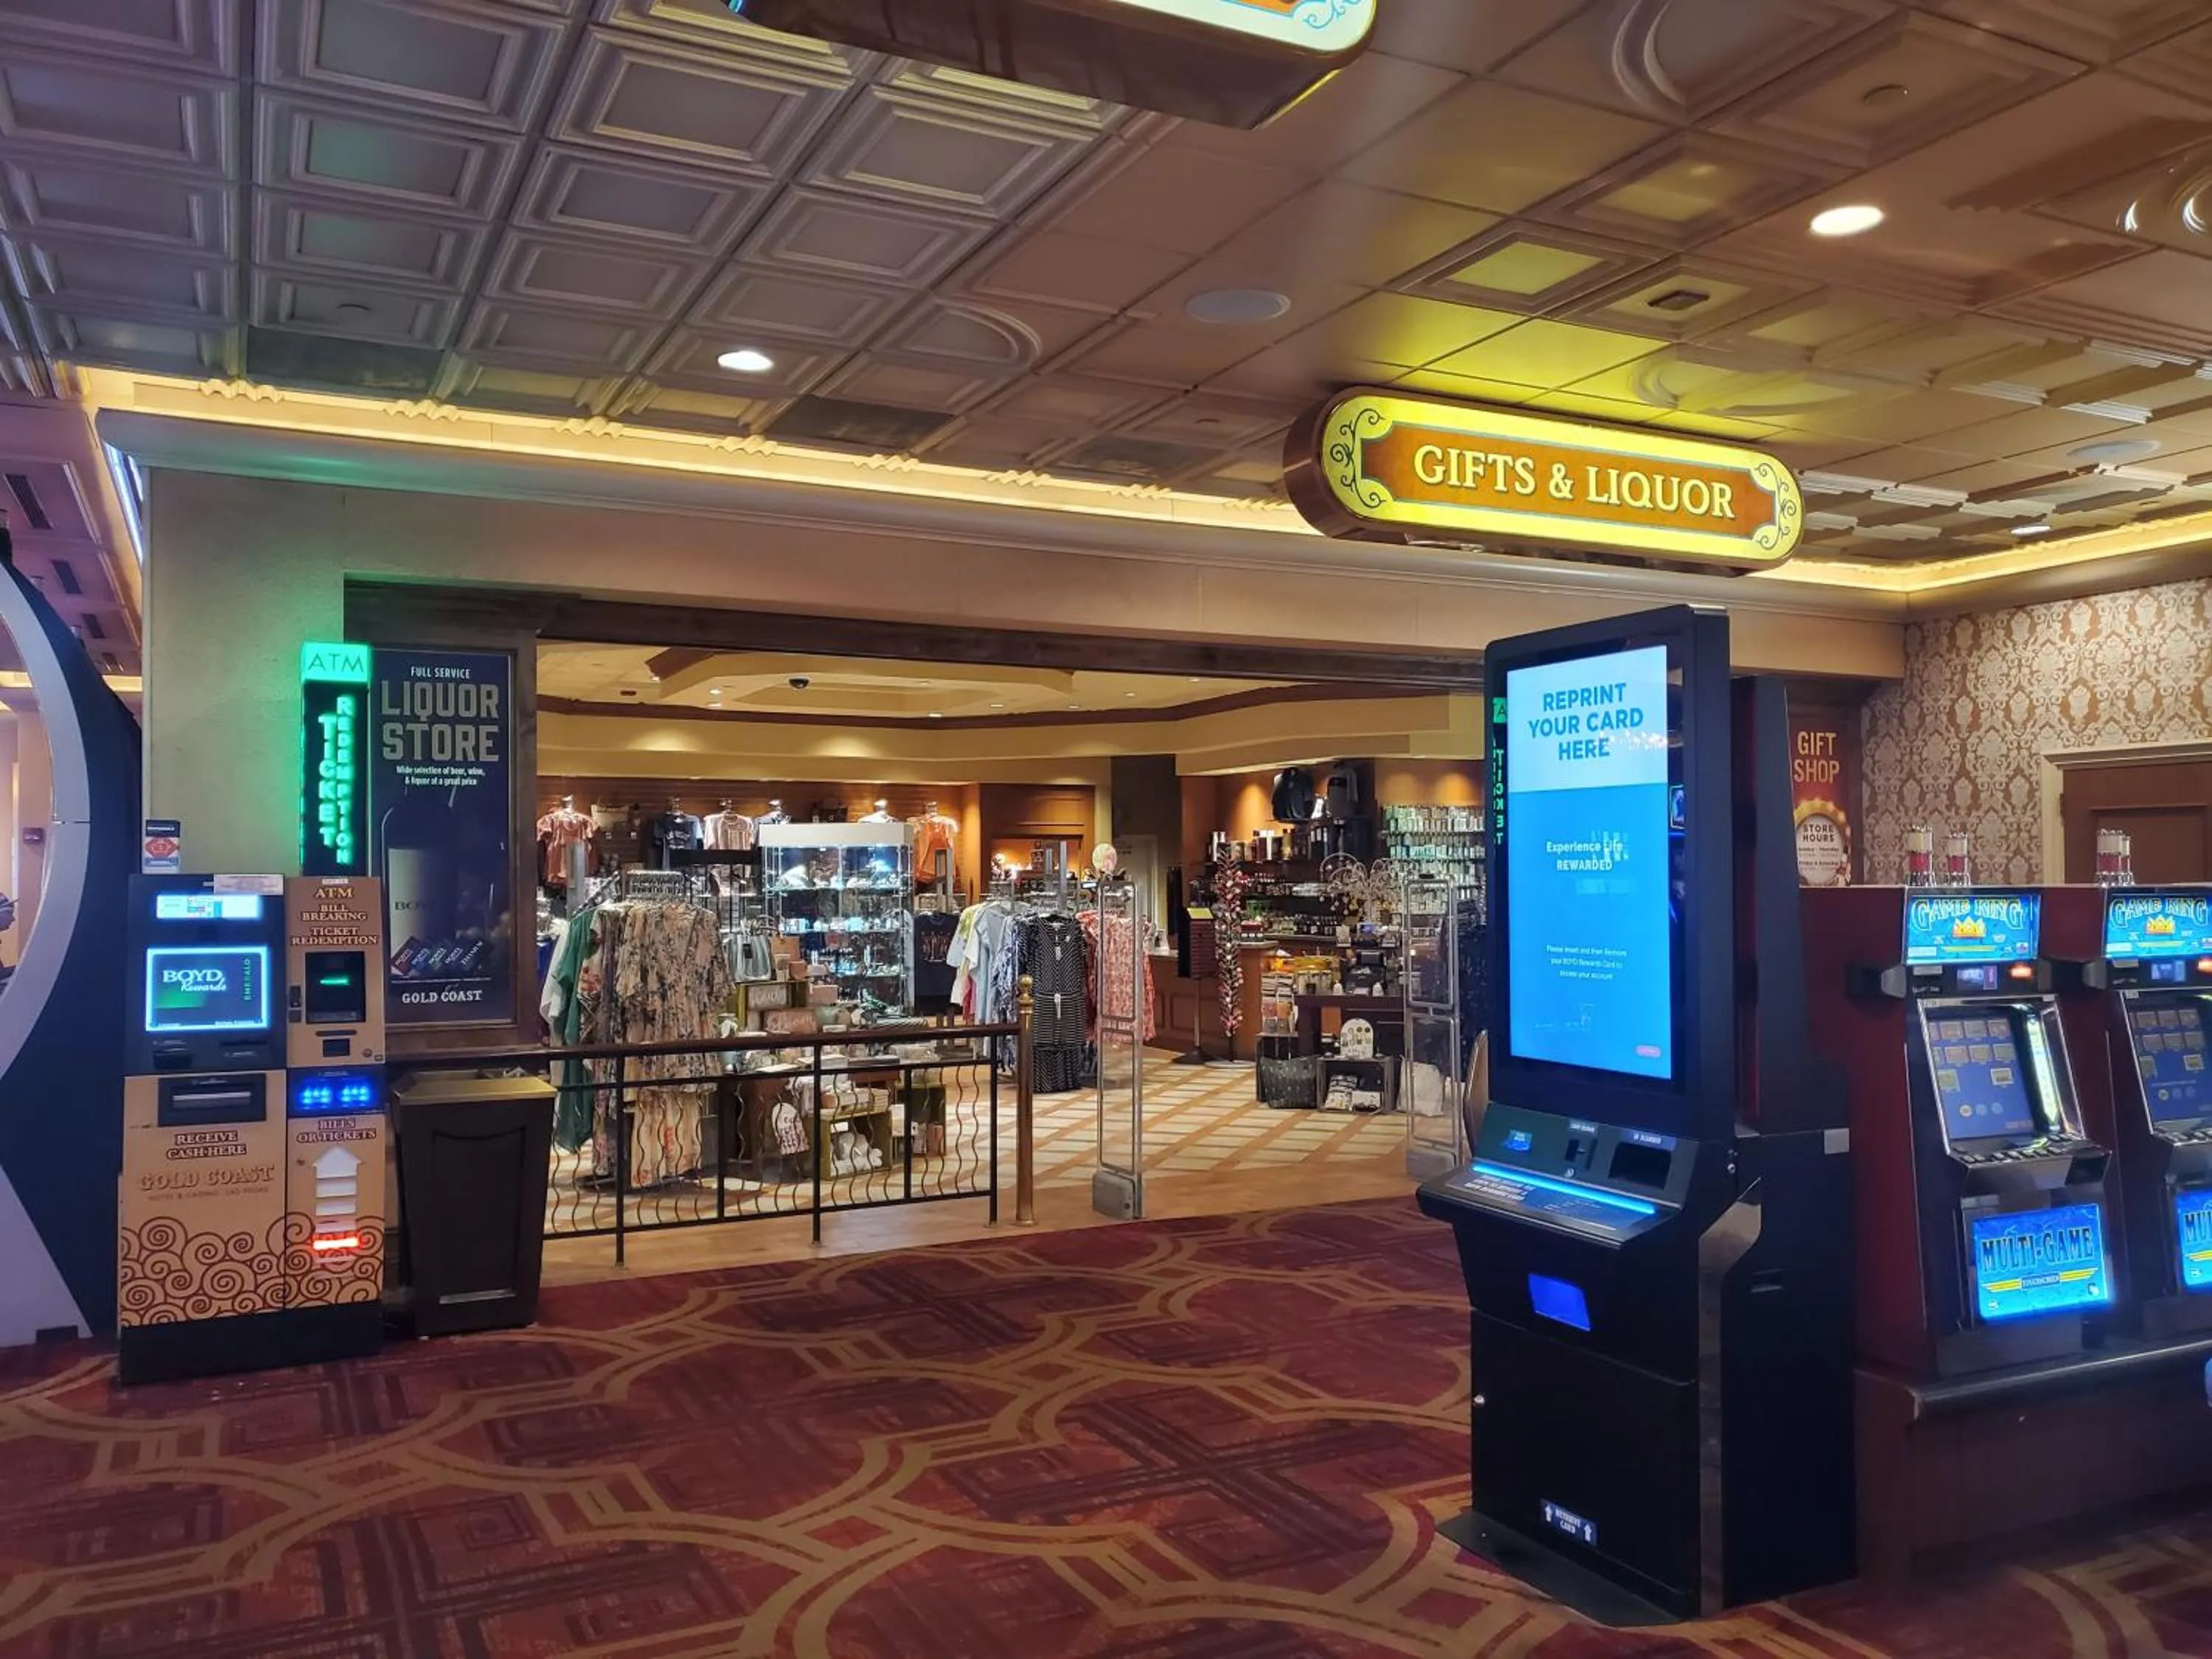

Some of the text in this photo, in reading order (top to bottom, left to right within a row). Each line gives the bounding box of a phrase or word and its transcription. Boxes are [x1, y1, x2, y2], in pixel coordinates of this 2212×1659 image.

[1413, 444, 1736, 518] GIFTS & LIQUOR
[307, 653, 364, 672] ATM
[411, 666, 470, 679] FULL SERVICE
[381, 680, 499, 721] LIQUOR
[1543, 683, 1627, 712] REPRINT
[1528, 707, 1644, 738] YOUR CARD
[382, 722, 499, 762] STORE
[1557, 737, 1610, 761] HERE
[1797, 731, 1837, 756] GIFT
[1793, 759, 1840, 784] SHOP
[318, 714, 337, 846] TICKET
[336, 696, 352, 863] REDEMPTION
[1804, 824, 1834, 833] STORE
[1803, 834, 1834, 842] HOURS
[1546, 841, 1601, 855] Experience
[1557, 860, 1613, 871] REWARDED
[315, 887, 353, 898] ATM
[320, 904, 349, 912] BILL
[1912, 899, 2024, 931] GAME KING
[2110, 898, 2208, 928] GAME KING
[302, 912, 367, 921] BREAKING
[311, 927, 359, 936] TICKET
[292, 936, 378, 945] REDEMPTION
[162, 970, 223, 983] BOYD
[181, 978, 227, 992] Rewards
[402, 990, 482, 1004] GOLD COAST
[319, 1119, 355, 1129] BILLS
[176, 1131, 237, 1145] RECEIVE
[319, 1129, 376, 1141] TICKETS
[167, 1145, 246, 1159] CASH HERE
[140, 1164, 276, 1192] GOLD COAST
[1981, 1227, 2095, 1273] MULTI-GAME
